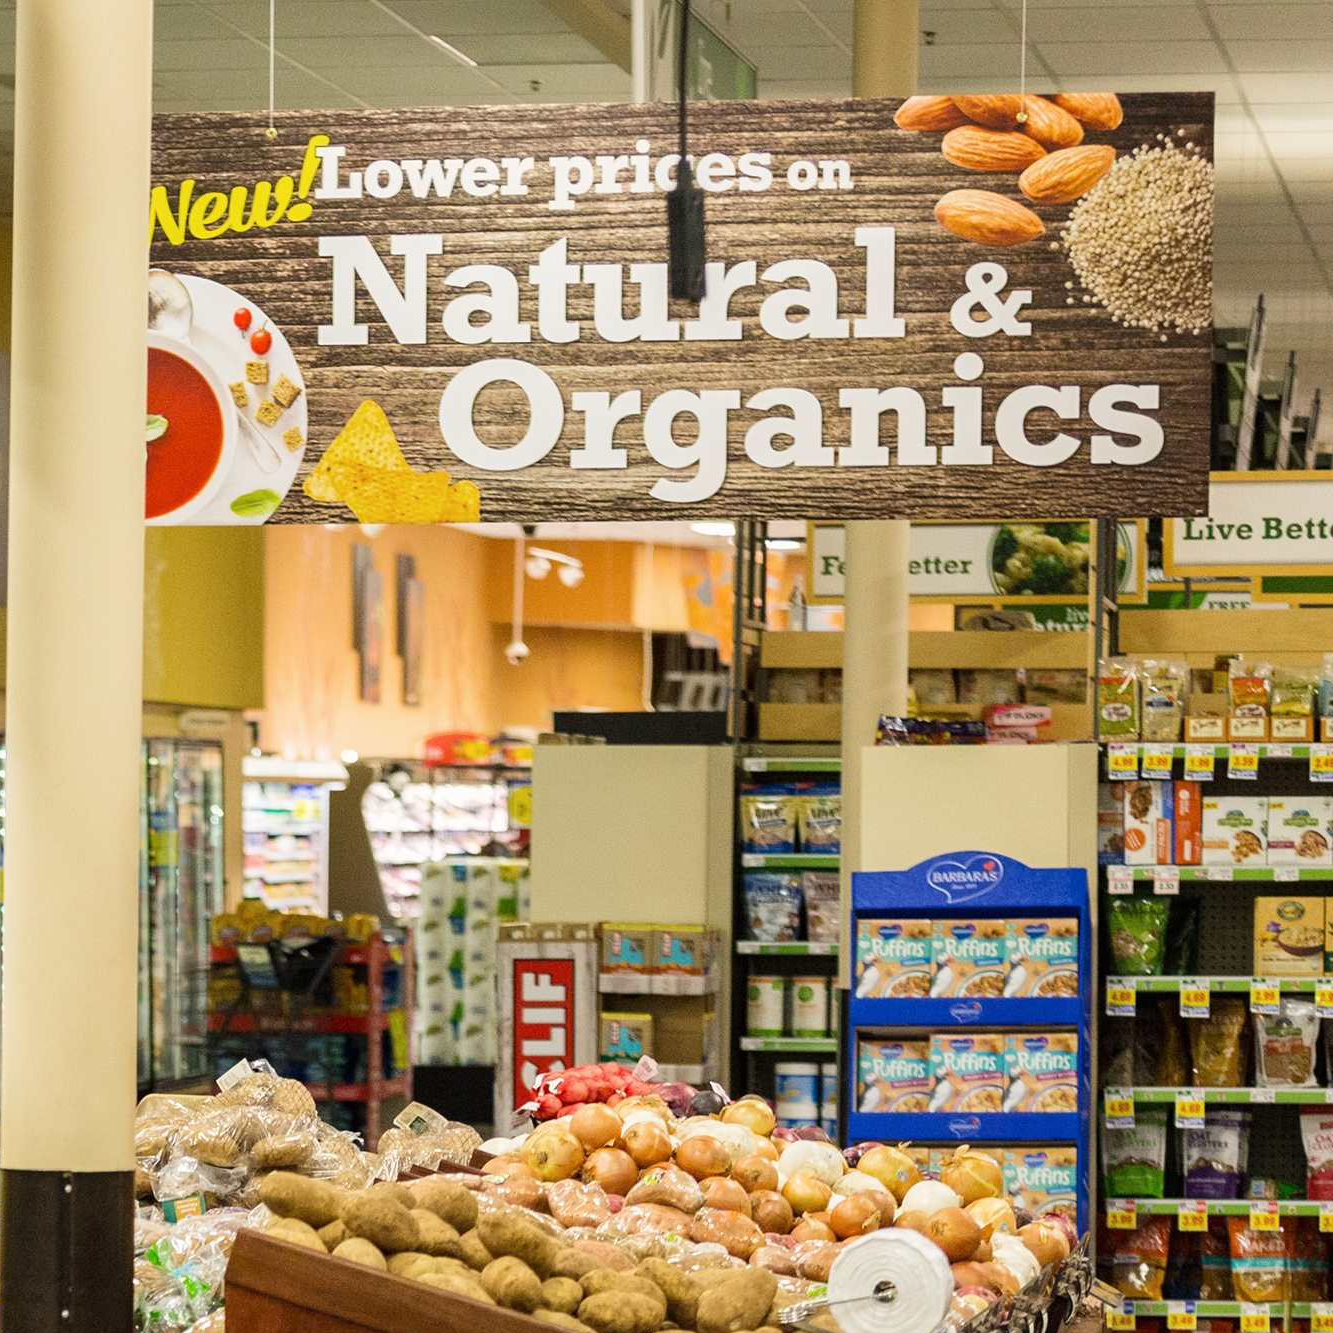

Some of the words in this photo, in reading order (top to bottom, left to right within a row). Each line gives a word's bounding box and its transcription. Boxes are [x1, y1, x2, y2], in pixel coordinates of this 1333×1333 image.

[314, 146, 535, 199] Lower
[548, 139, 773, 210] prices
[786, 161, 854, 191] on
[148, 135, 329, 246] New!
[317, 227, 906, 345] Natural
[949, 262, 1032, 337] &
[438, 352, 1166, 503] Organics
[1183, 517, 1253, 541] Live
[820, 556, 846, 577] Fe
[909, 556, 973, 576] etter
[872, 938, 926, 958] Puffins
[945, 938, 999, 958] Puffins
[1018, 937, 1072, 957] Puffins
[944, 1052, 998, 1072] Puffins
[1018, 1051, 1072, 1071] Puffins
[1017, 1166, 1072, 1186] Puffins
